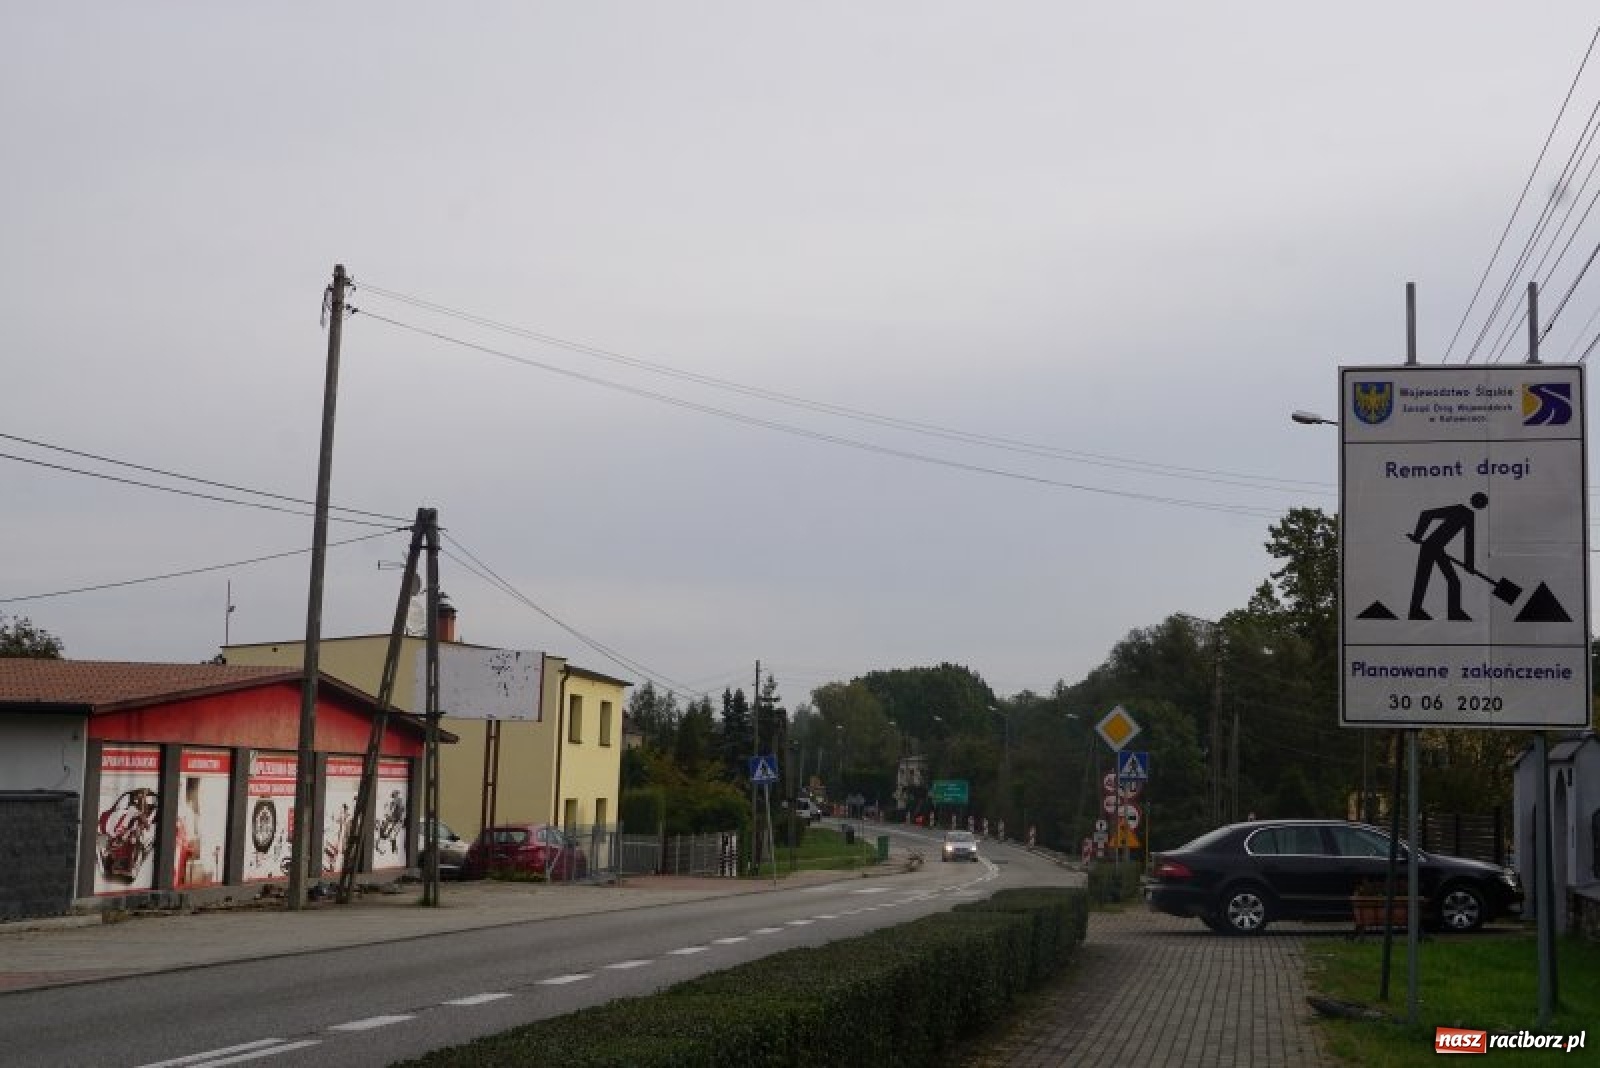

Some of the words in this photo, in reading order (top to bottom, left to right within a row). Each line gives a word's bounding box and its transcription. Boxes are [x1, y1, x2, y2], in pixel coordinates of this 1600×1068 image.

[1385, 461, 1462, 478] Remont
[1477, 457, 1531, 481] drogi
[1351, 661, 1449, 679] Planowane
[1461, 661, 1573, 681] zakończenie
[1388, 694, 1411, 710] 30
[1421, 694, 1444, 711] 06
[1457, 695, 1503, 712] 2020
